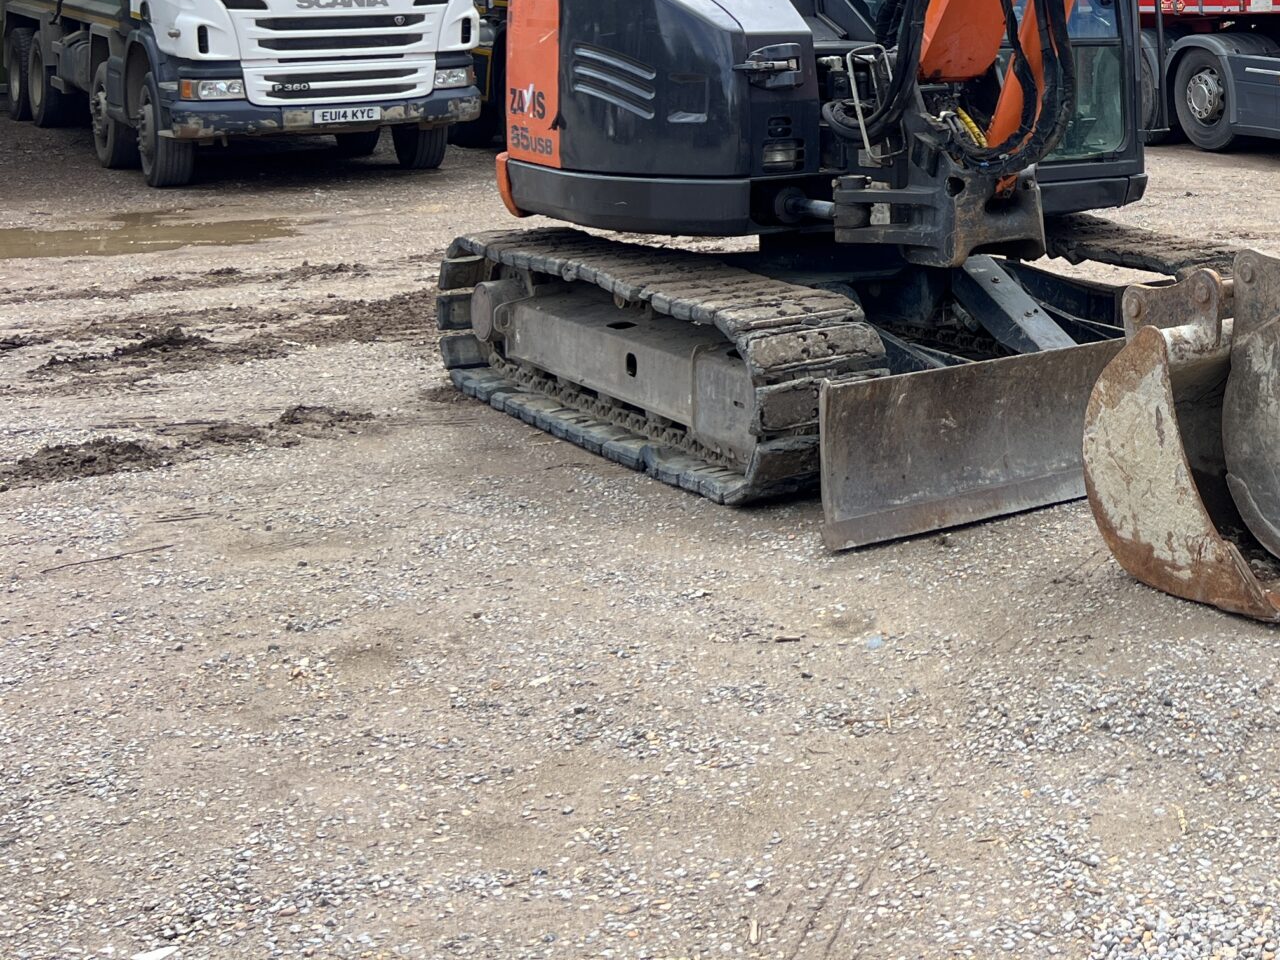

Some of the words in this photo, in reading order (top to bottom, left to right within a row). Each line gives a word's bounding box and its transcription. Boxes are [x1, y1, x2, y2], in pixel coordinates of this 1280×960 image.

[274, 84, 283, 92] P
[284, 83, 309, 92] 360
[321, 110, 348, 121] EU14
[351, 108, 374, 120] KYC
